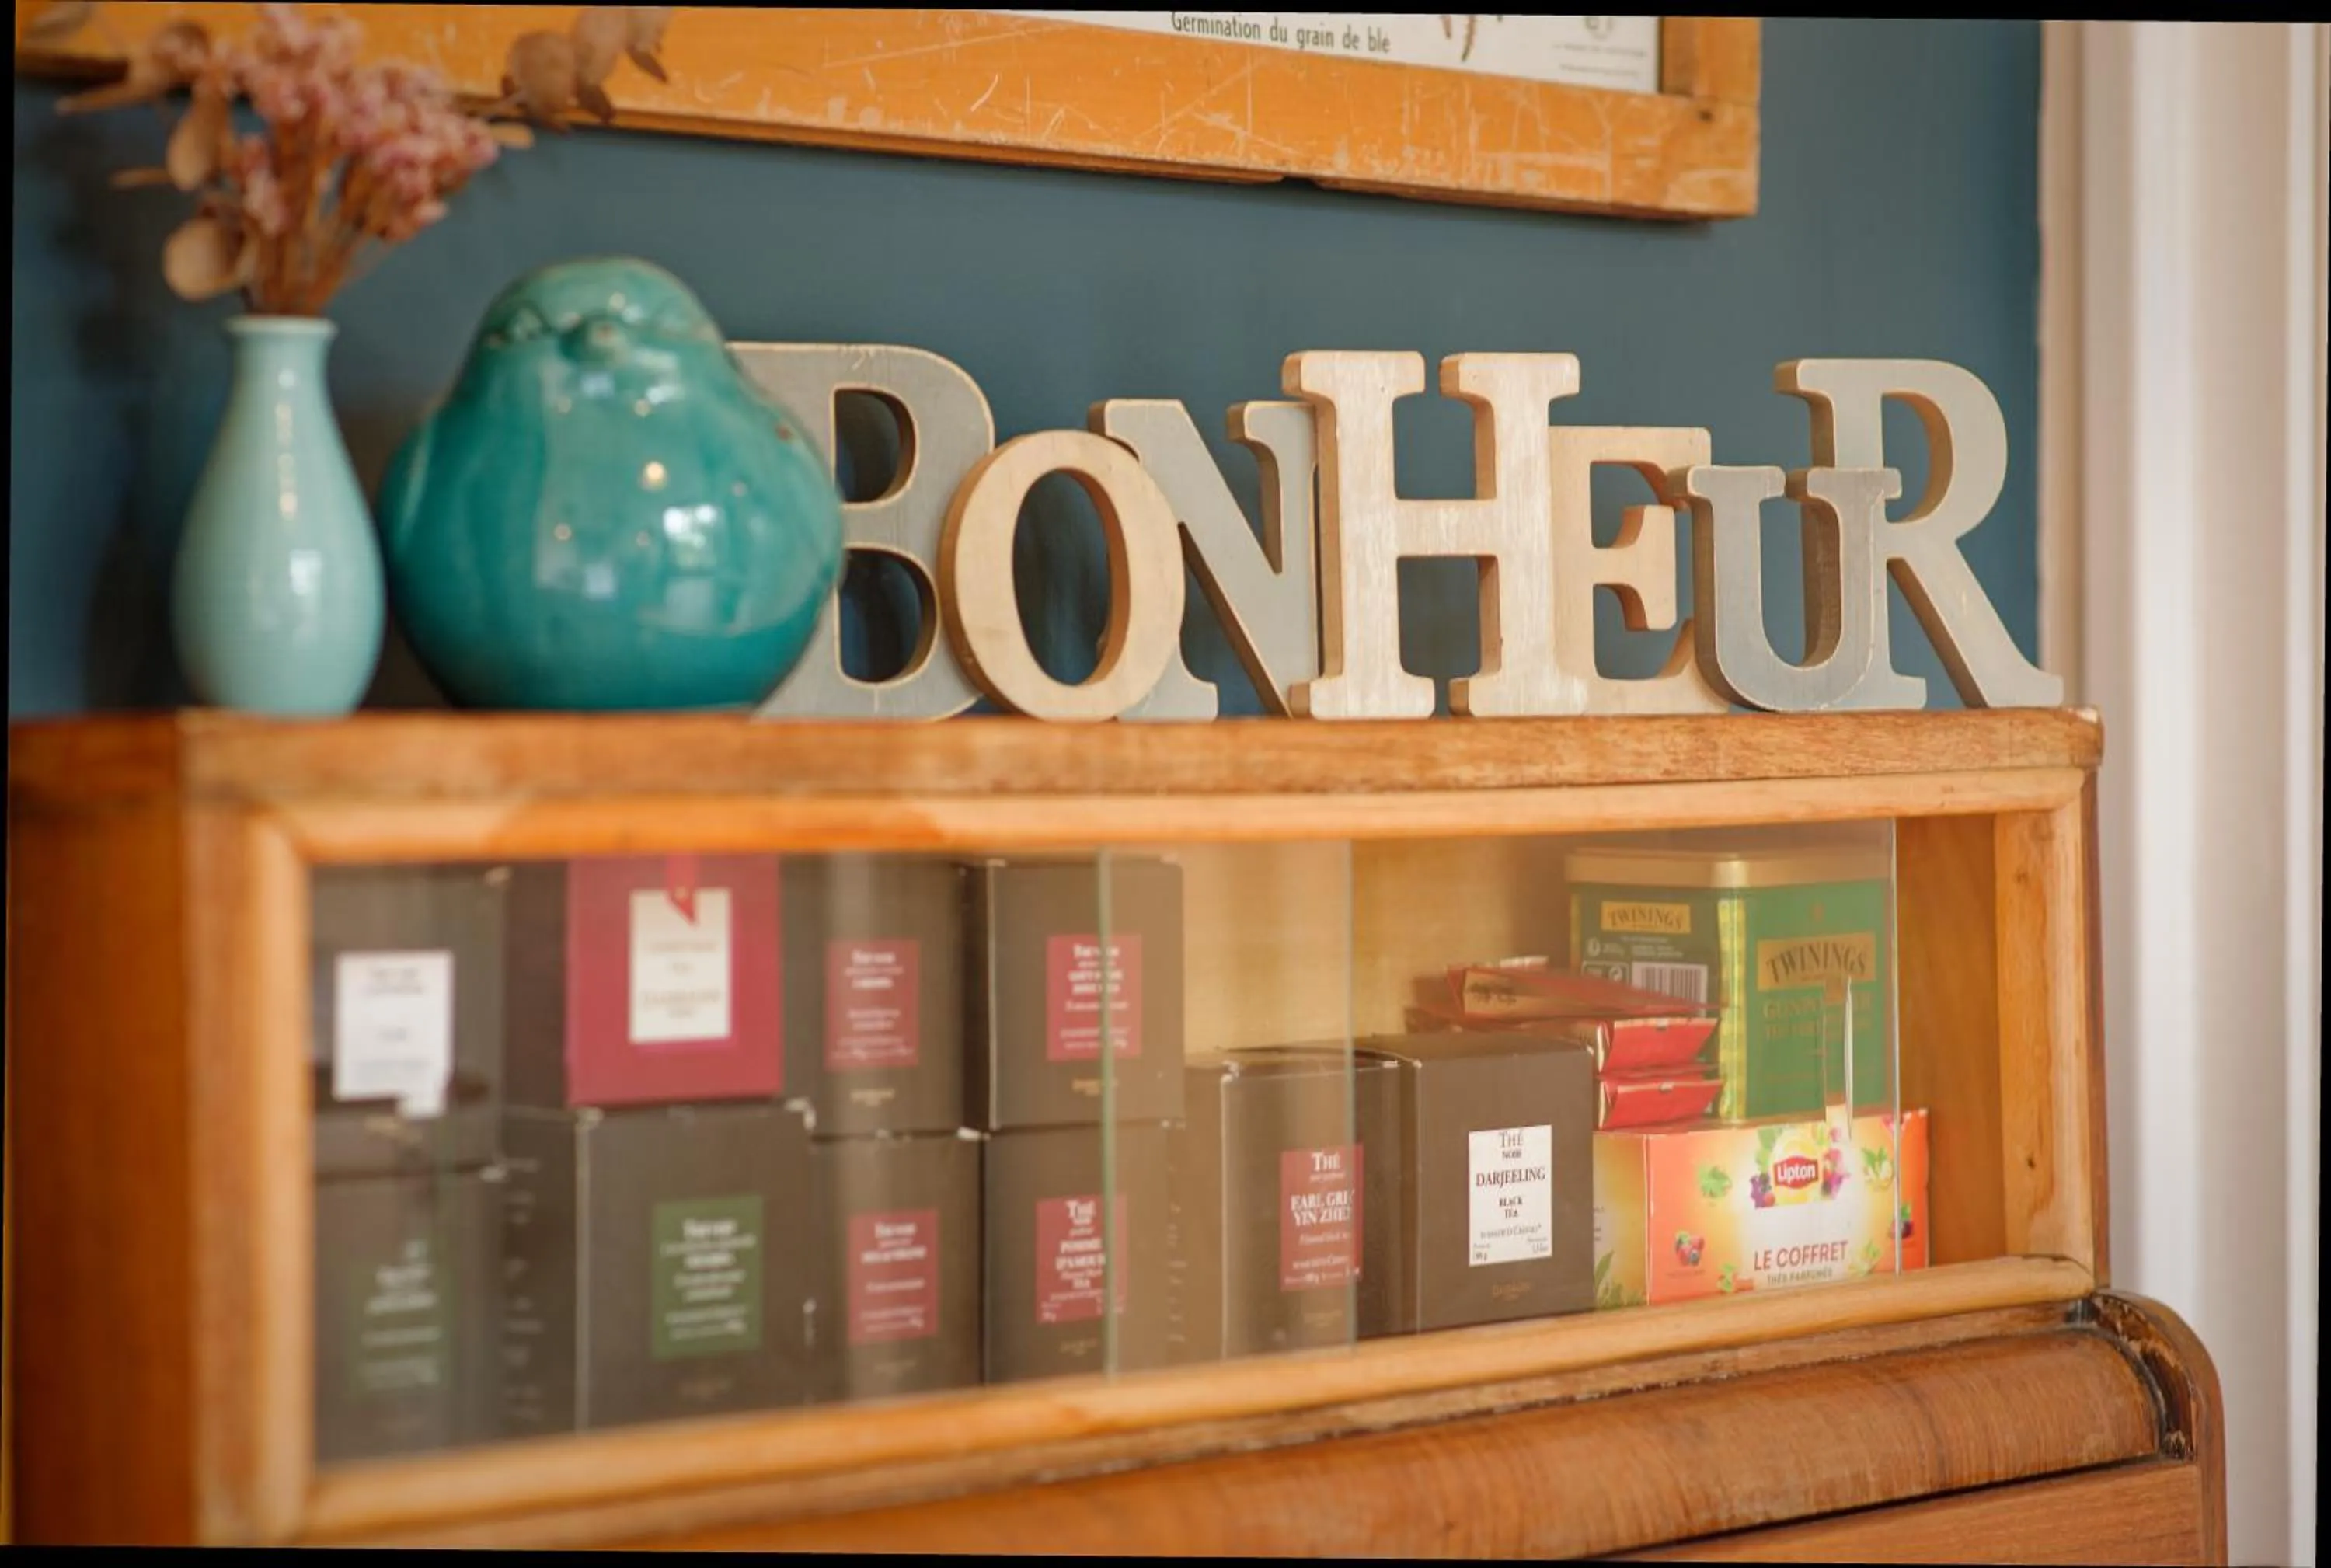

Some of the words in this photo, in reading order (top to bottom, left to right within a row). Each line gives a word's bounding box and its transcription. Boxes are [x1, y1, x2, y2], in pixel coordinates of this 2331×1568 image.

[1171, 12, 1261, 39] Germination
[1270, 17, 1287, 43] du
[1297, 22, 1334, 49] grain
[1343, 25, 1359, 50] de
[729, 342, 2064, 723] BONHEUR
[1608, 905, 1683, 929] TWININGS
[1766, 941, 1866, 983] TWININGS
[1476, 1166, 1545, 1187] DARJEELING
[1777, 1164, 1816, 1183] Lipton
[1499, 1197, 1523, 1207] BLACK
[1504, 1209, 1518, 1218] TEA
[1754, 1250, 1773, 1271] LE
[1776, 1240, 1848, 1267] COFFRET
